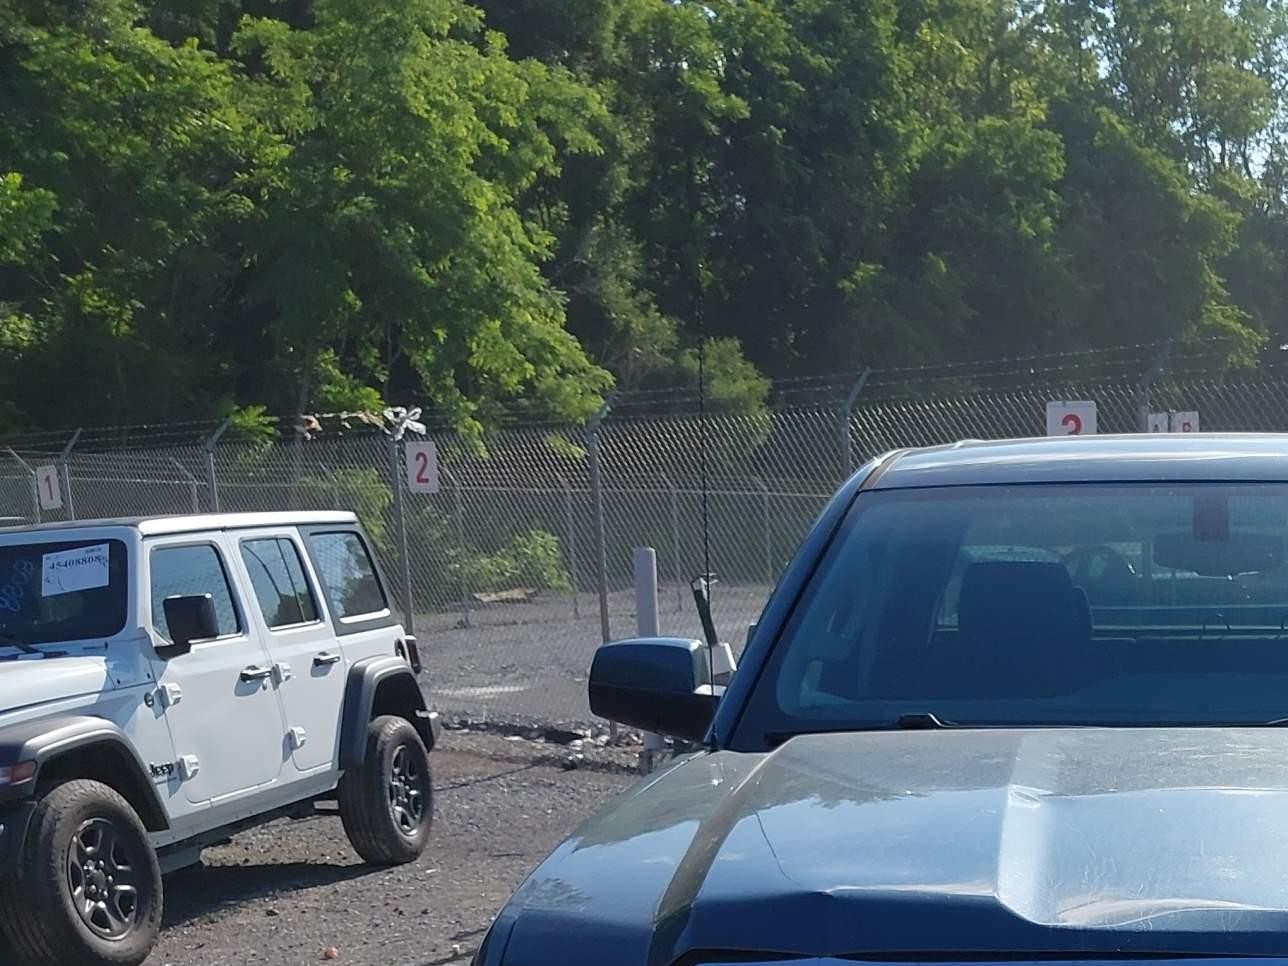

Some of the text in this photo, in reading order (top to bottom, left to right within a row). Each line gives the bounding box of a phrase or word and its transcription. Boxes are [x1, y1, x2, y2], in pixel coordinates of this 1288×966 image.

[415, 451, 429, 484] 2
[44, 474, 53, 501] 1
[149, 763, 174, 778] Jeep
